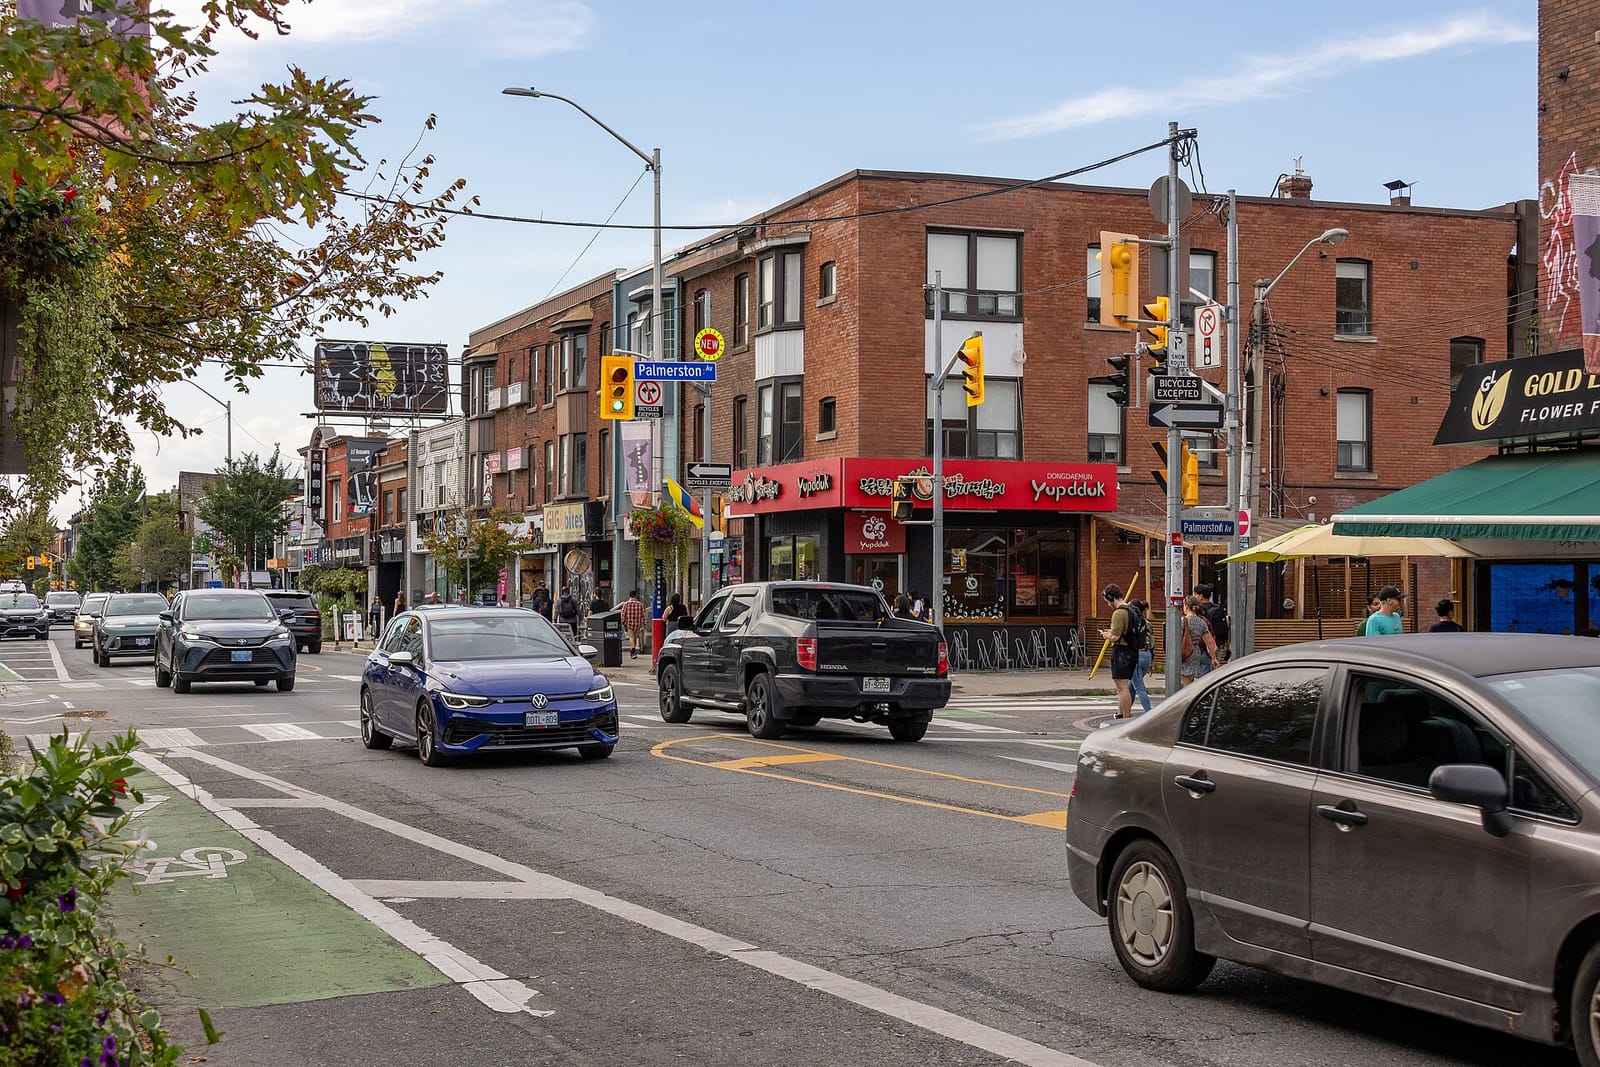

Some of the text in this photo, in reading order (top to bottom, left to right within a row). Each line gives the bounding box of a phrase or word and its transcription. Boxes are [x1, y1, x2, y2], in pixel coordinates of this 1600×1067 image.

[701, 339, 719, 350] NEW
[639, 364, 702, 377] Palmerston
[1159, 379, 1197, 388] BICYCLES
[1524, 368, 1583, 398] GOLD
[1157, 389, 1199, 398] EXCEPTED
[1520, 403, 1584, 423] FLOWER
[1047, 472, 1093, 480] DONGDAEMUN
[1031, 480, 1106, 502] Yupdduk
[1183, 522, 1223, 533] Palmerston
[860, 540, 889, 550] Yupdduk
